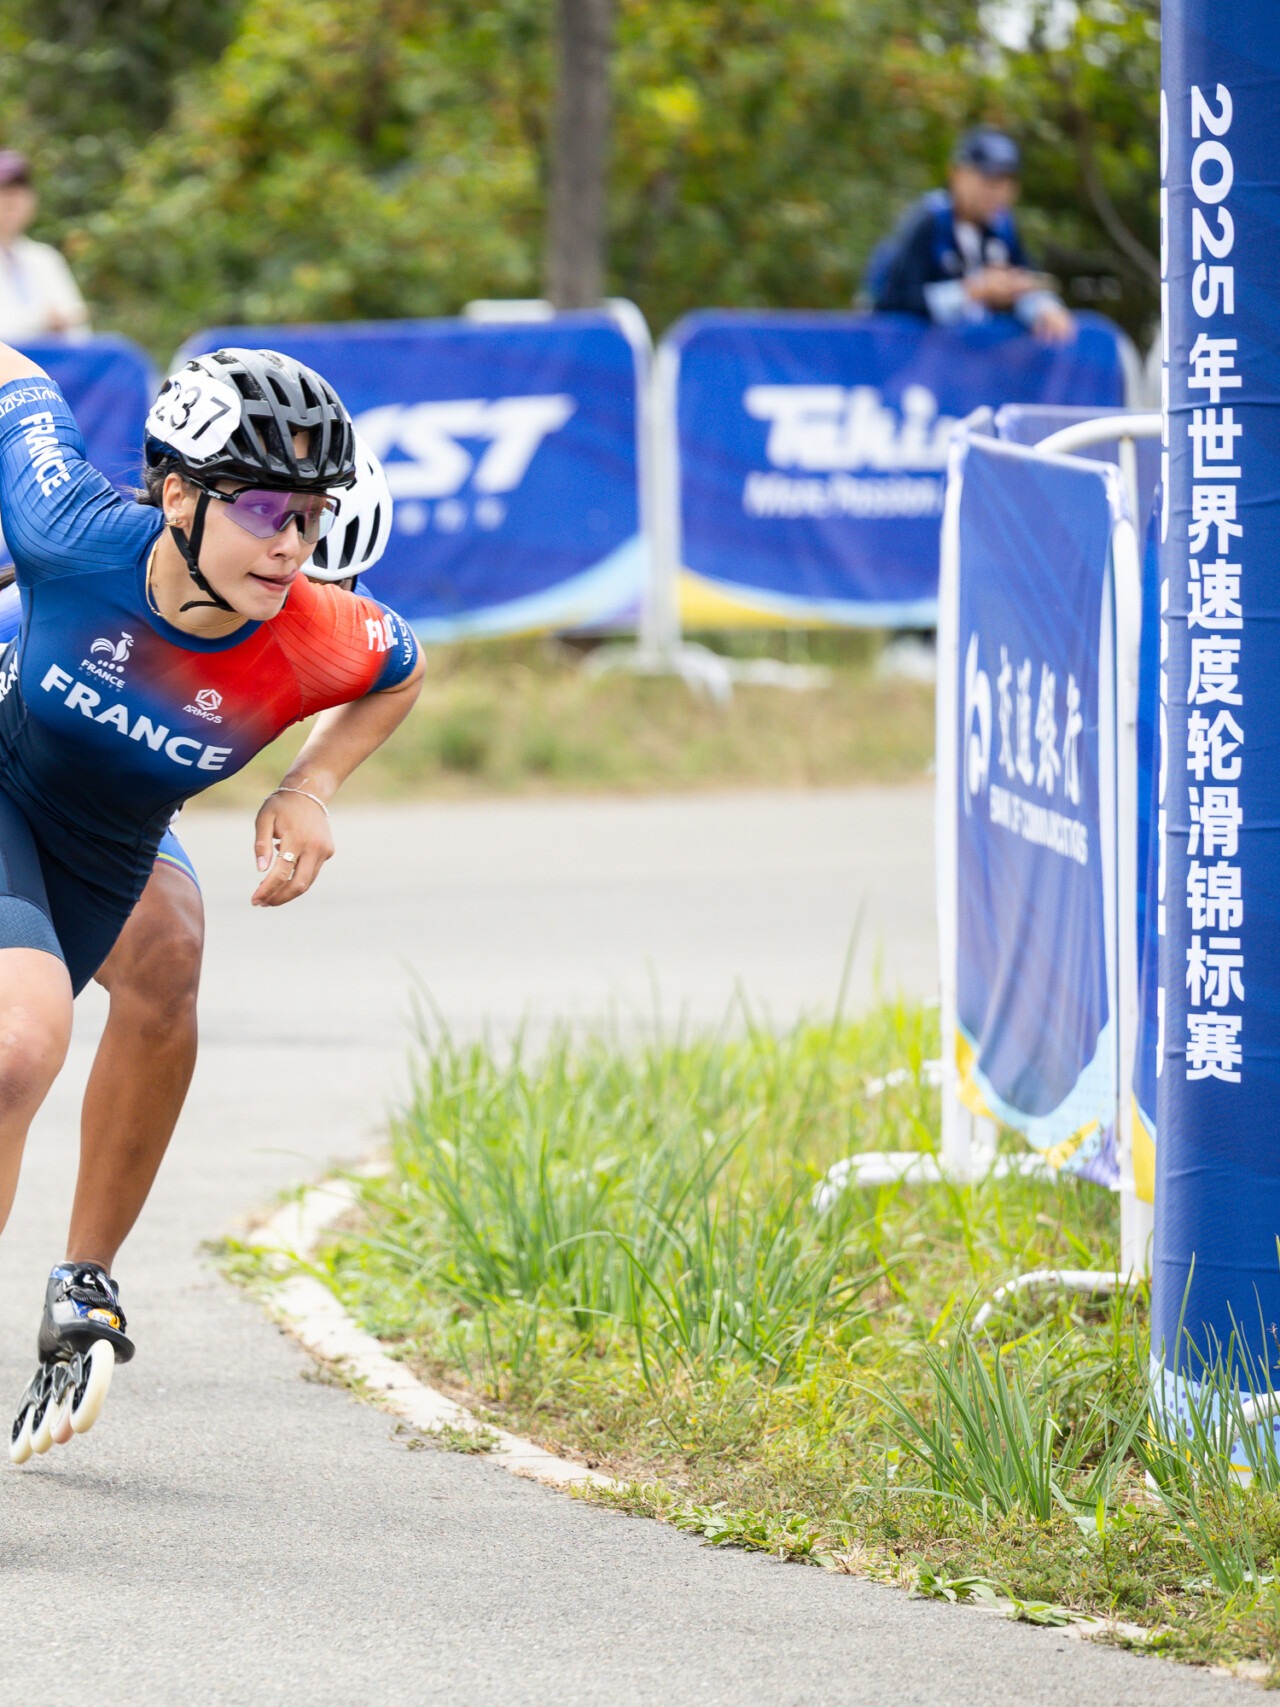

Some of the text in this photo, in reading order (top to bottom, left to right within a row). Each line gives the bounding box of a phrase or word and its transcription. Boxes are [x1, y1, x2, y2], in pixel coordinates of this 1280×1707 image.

[19, 411, 72, 497] FRANCE
[81, 659, 126, 689] FRANCE
[40, 663, 233, 771] FRANCE
[182, 704, 223, 724] ARMOS
